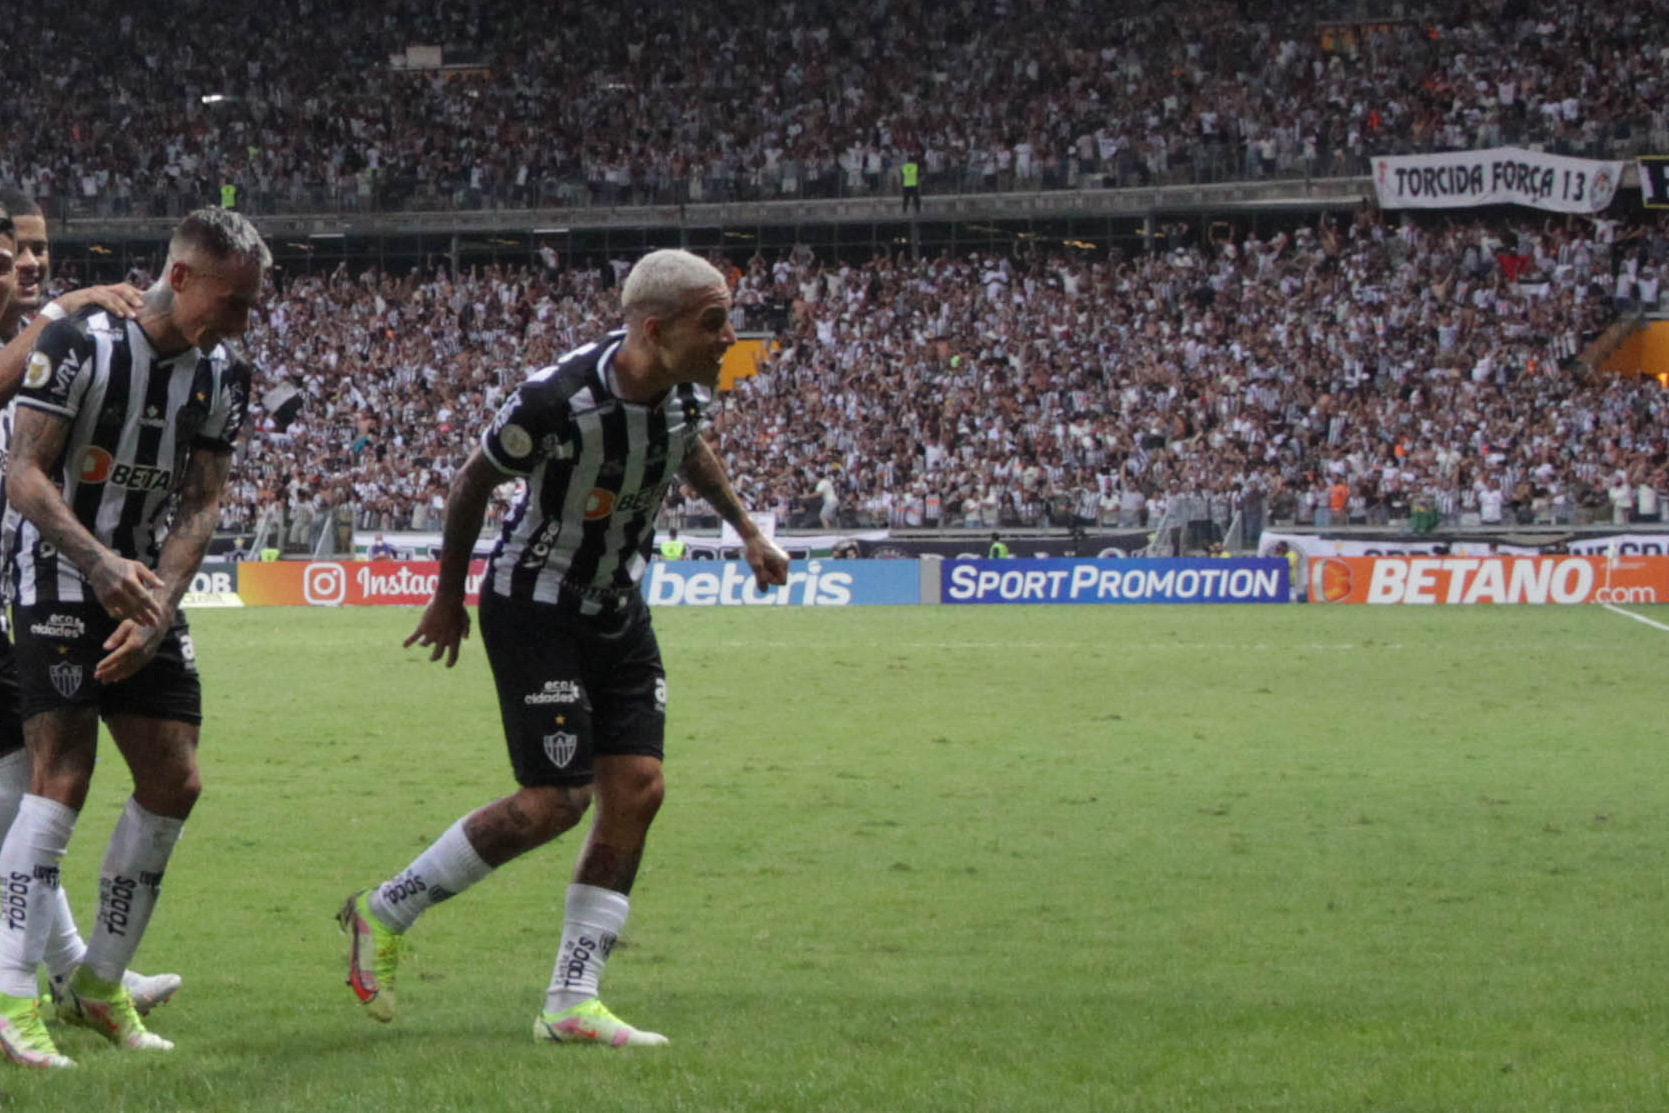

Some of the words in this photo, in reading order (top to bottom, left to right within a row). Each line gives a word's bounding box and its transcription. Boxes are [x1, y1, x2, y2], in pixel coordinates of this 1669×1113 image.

[1395, 164, 1483, 199] TORCIDA
[1491, 160, 1555, 202] FORÇA
[1562, 169, 1586, 202] 13
[948, 564, 1069, 599] SPORT
[1069, 564, 1280, 599] PROMOTION
[9, 872, 31, 931] TODOS
[106, 875, 137, 936] TODOS
[564, 936, 596, 987] TODOS
